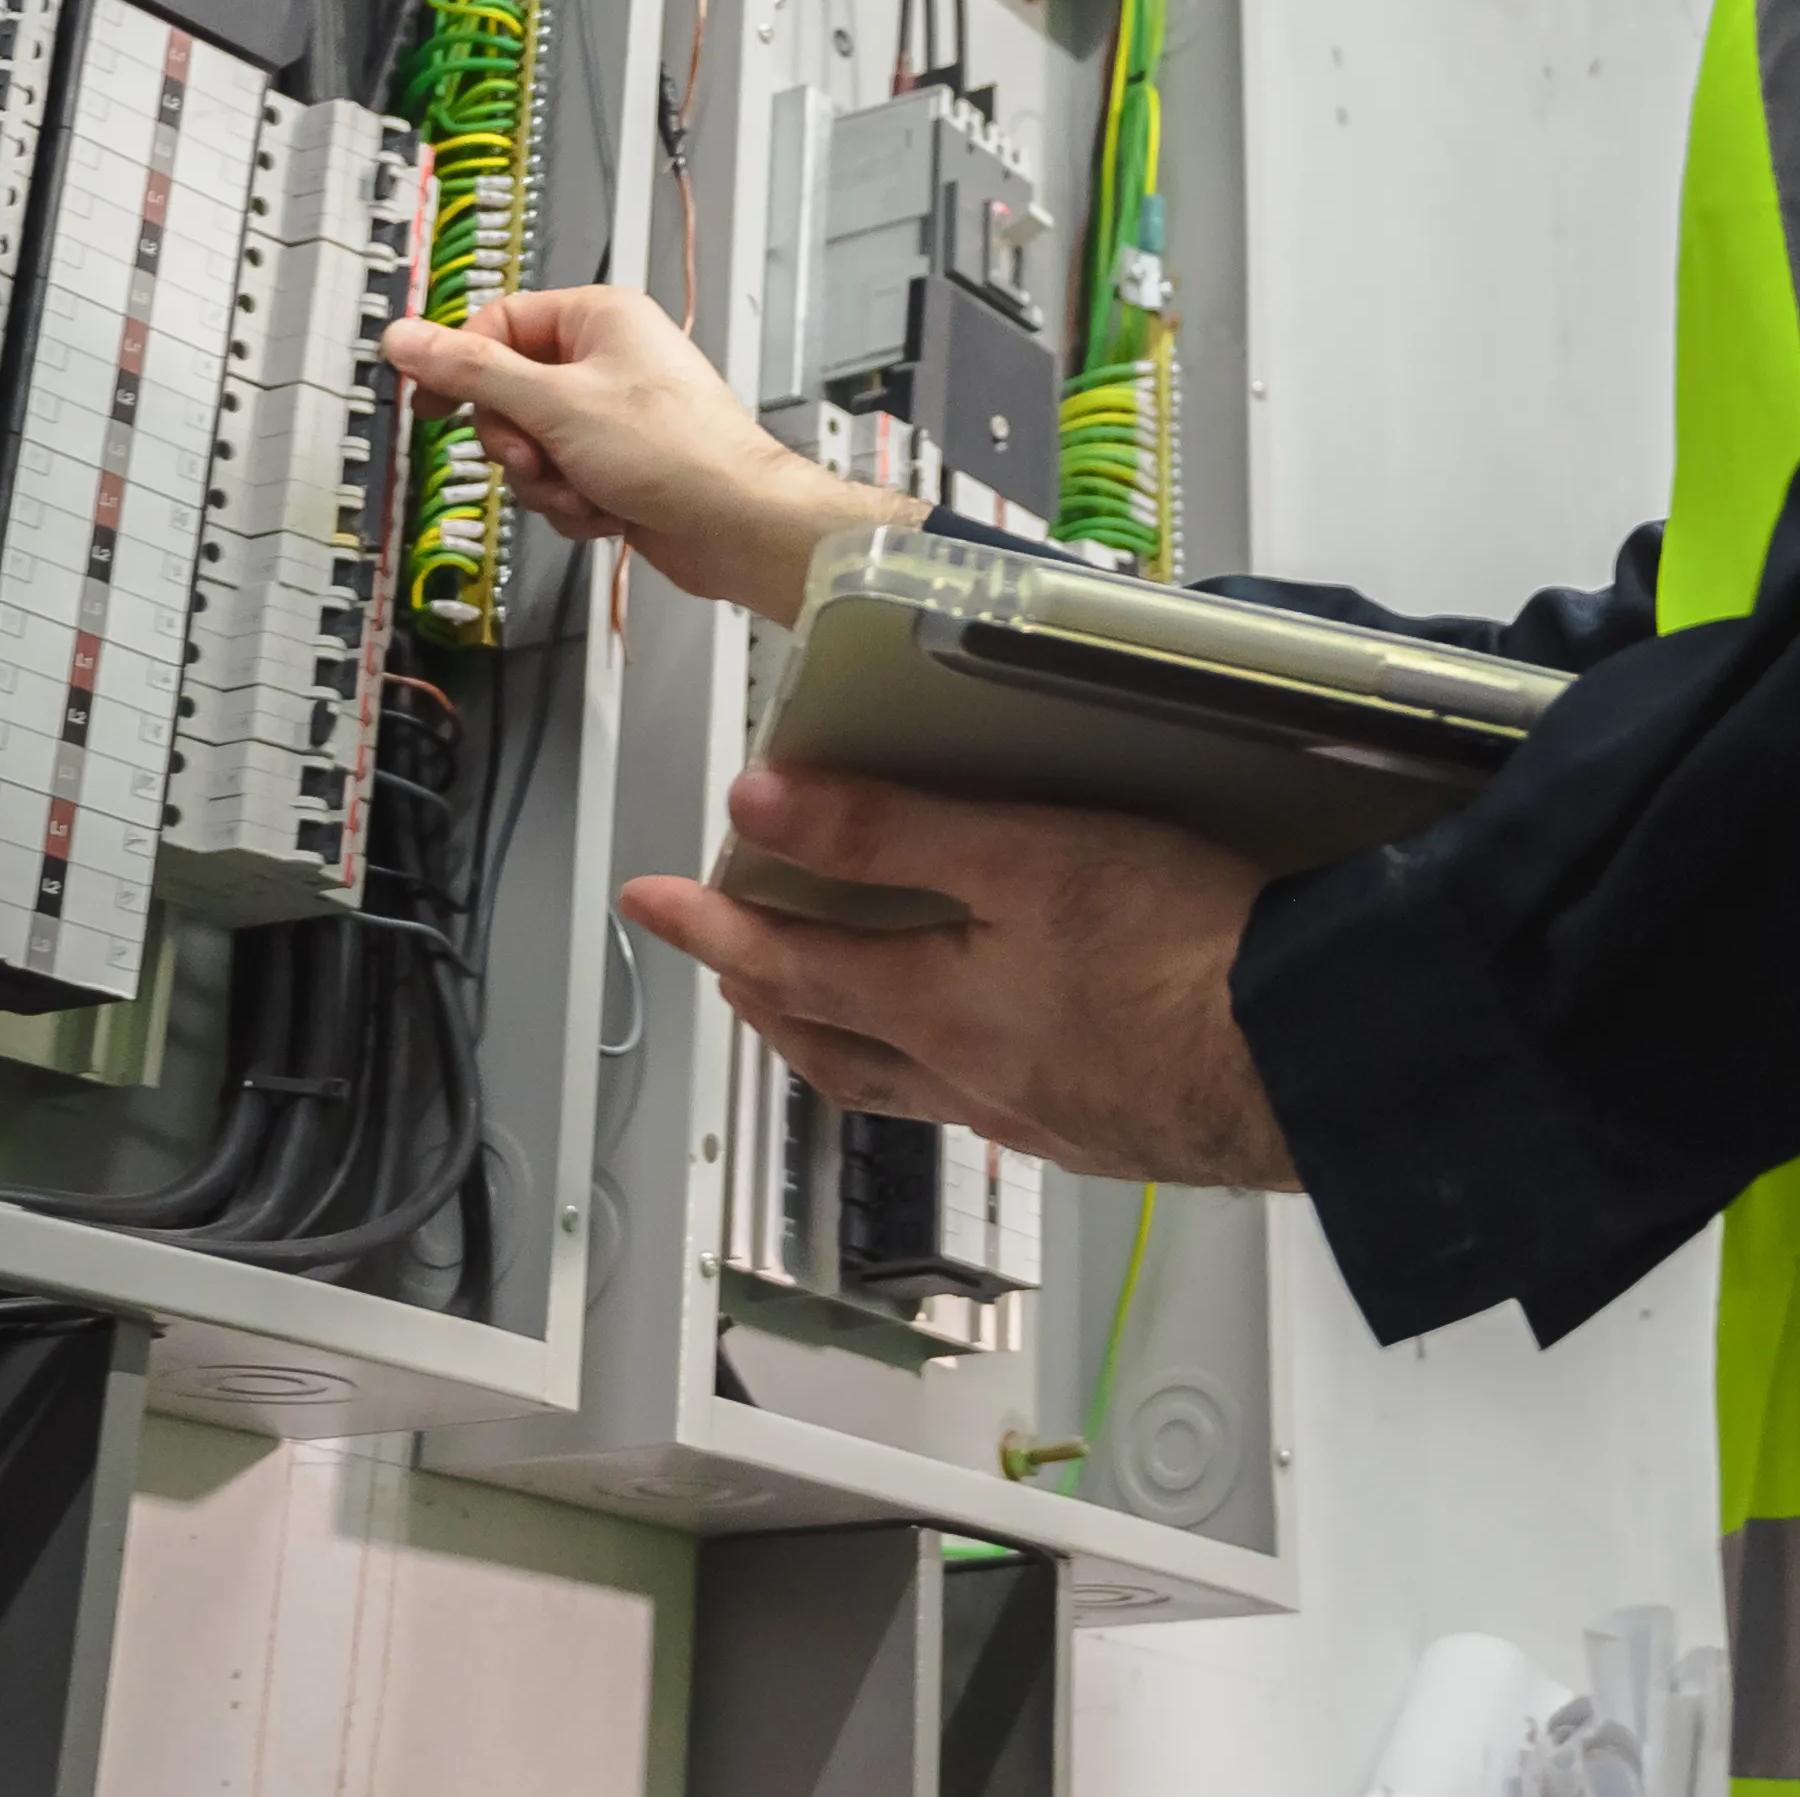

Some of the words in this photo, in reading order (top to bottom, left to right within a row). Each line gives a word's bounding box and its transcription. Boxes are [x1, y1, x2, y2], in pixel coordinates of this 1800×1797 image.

[162, 93, 182, 111] L2
[146, 189, 165, 205] L1
[139, 238, 159, 257] L2
[123, 337, 142, 353] L1
[116, 388, 136, 406] L2
[99, 492, 118, 508] L1
[91, 545, 112, 563] L2
[75, 652, 94, 670] L1
[67, 707, 88, 725] L2
[50, 819, 69, 838] L1
[41, 877, 62, 896] L2
